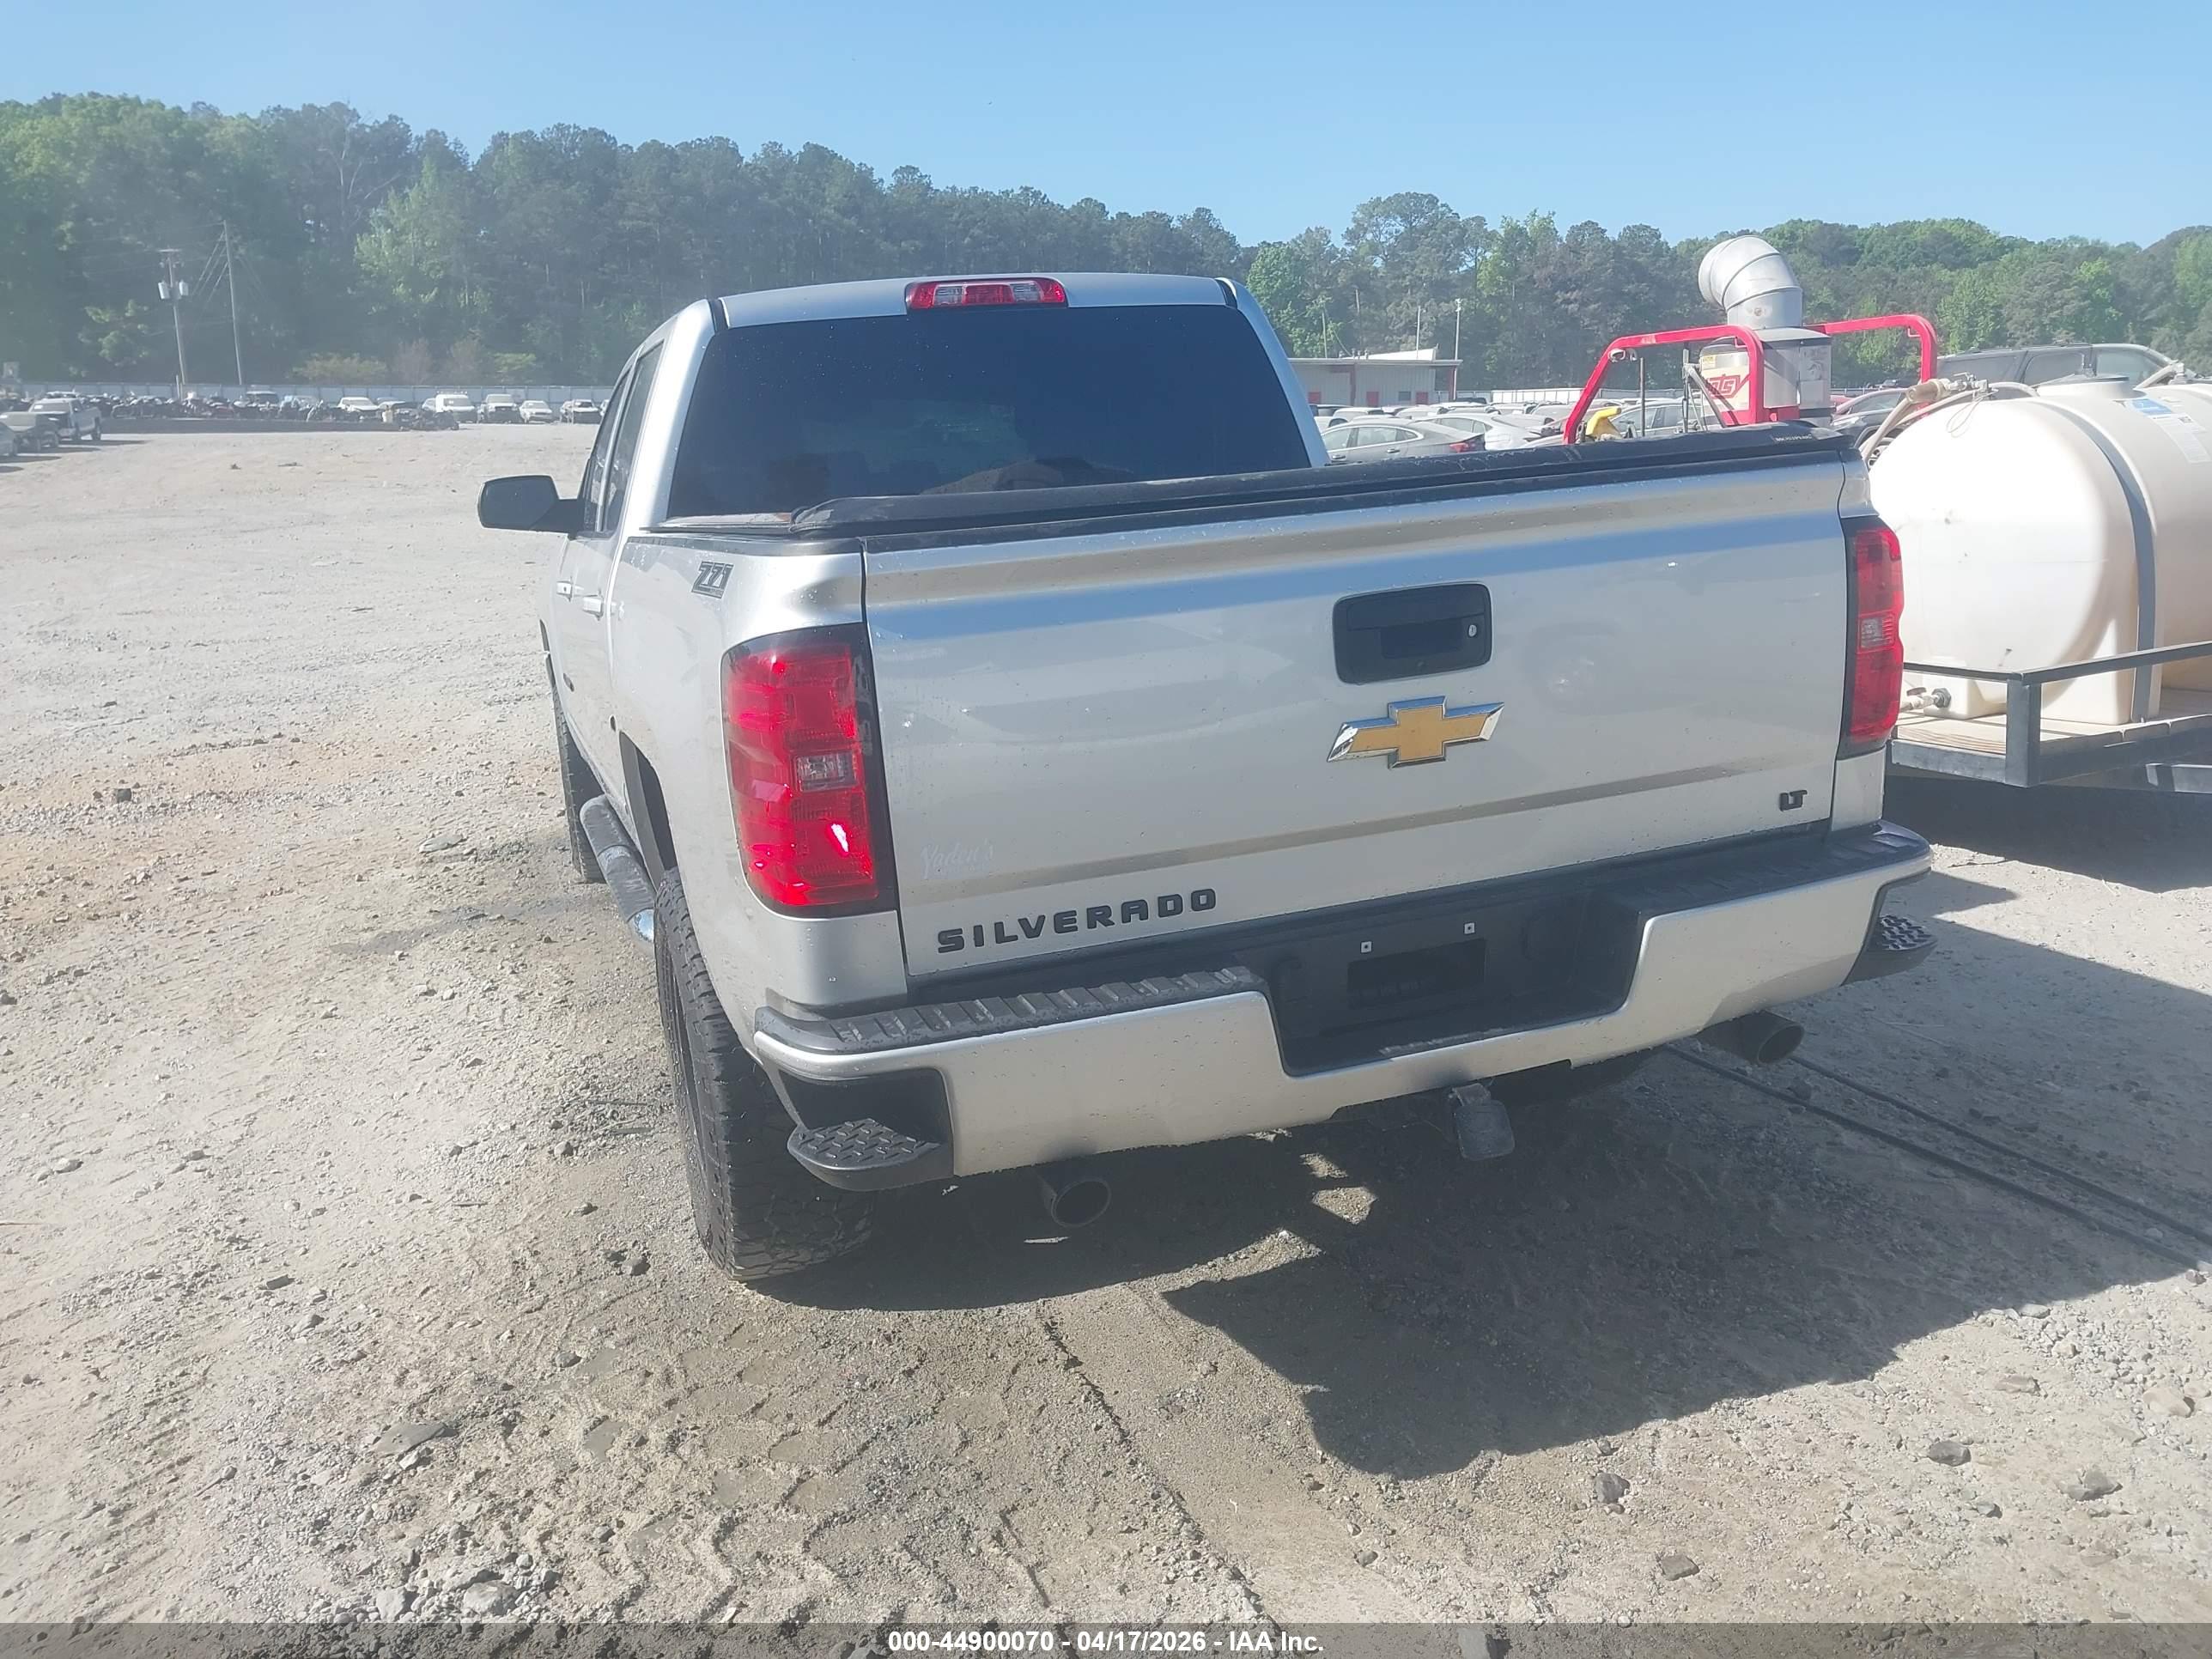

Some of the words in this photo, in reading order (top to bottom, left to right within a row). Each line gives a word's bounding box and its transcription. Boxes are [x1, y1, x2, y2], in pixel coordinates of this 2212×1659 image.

[691, 561, 734, 599] Z71
[1779, 789, 1808, 811] LT
[938, 888, 1217, 954] SILVERADO
